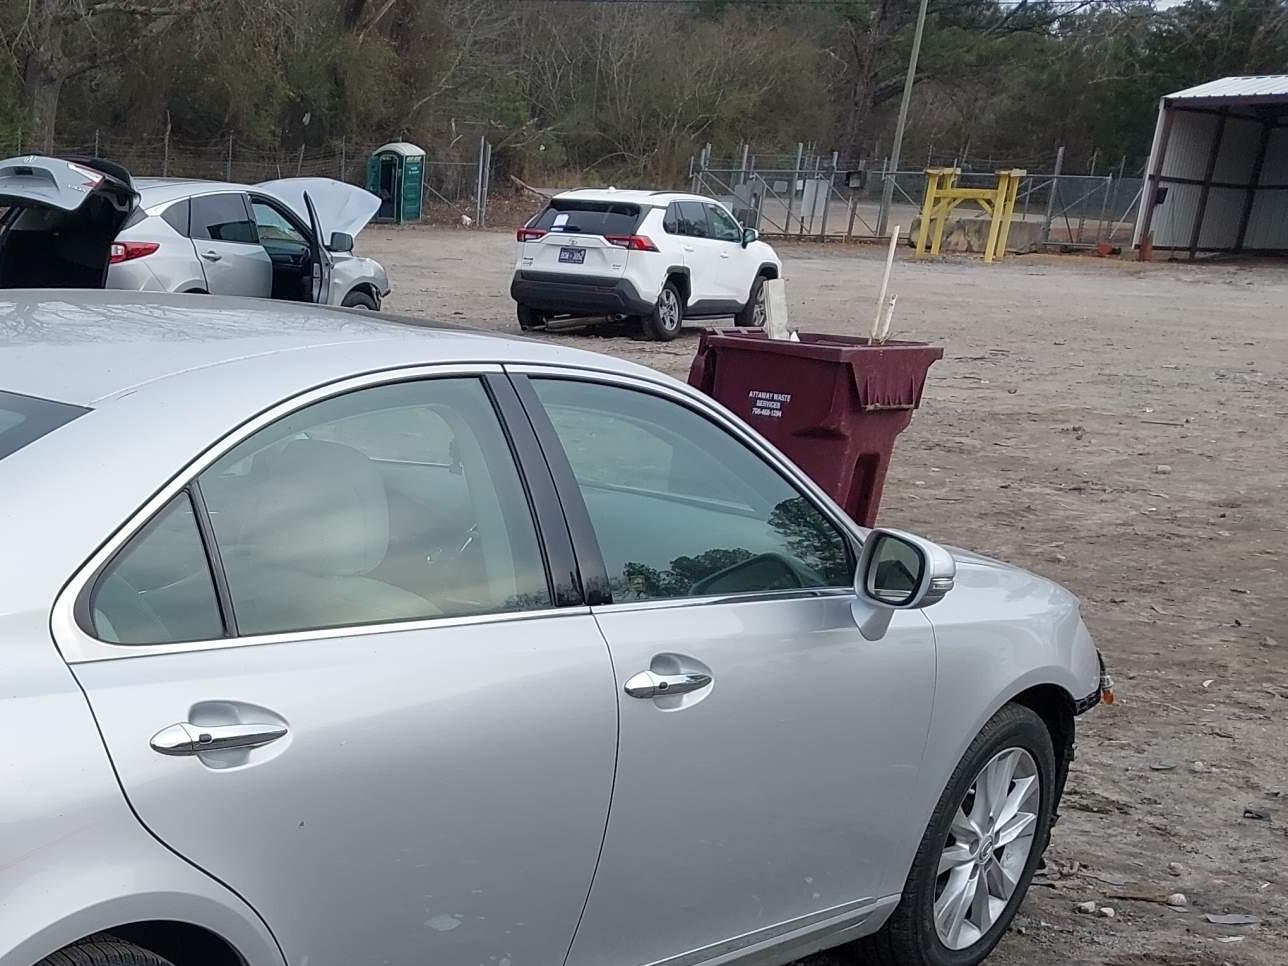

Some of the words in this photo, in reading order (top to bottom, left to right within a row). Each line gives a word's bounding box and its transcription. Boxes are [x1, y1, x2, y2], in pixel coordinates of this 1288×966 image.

[749, 390, 773, 399] ATTAWAY
[773, 393, 791, 402] WASTE
[756, 400, 781, 409] SERVICES
